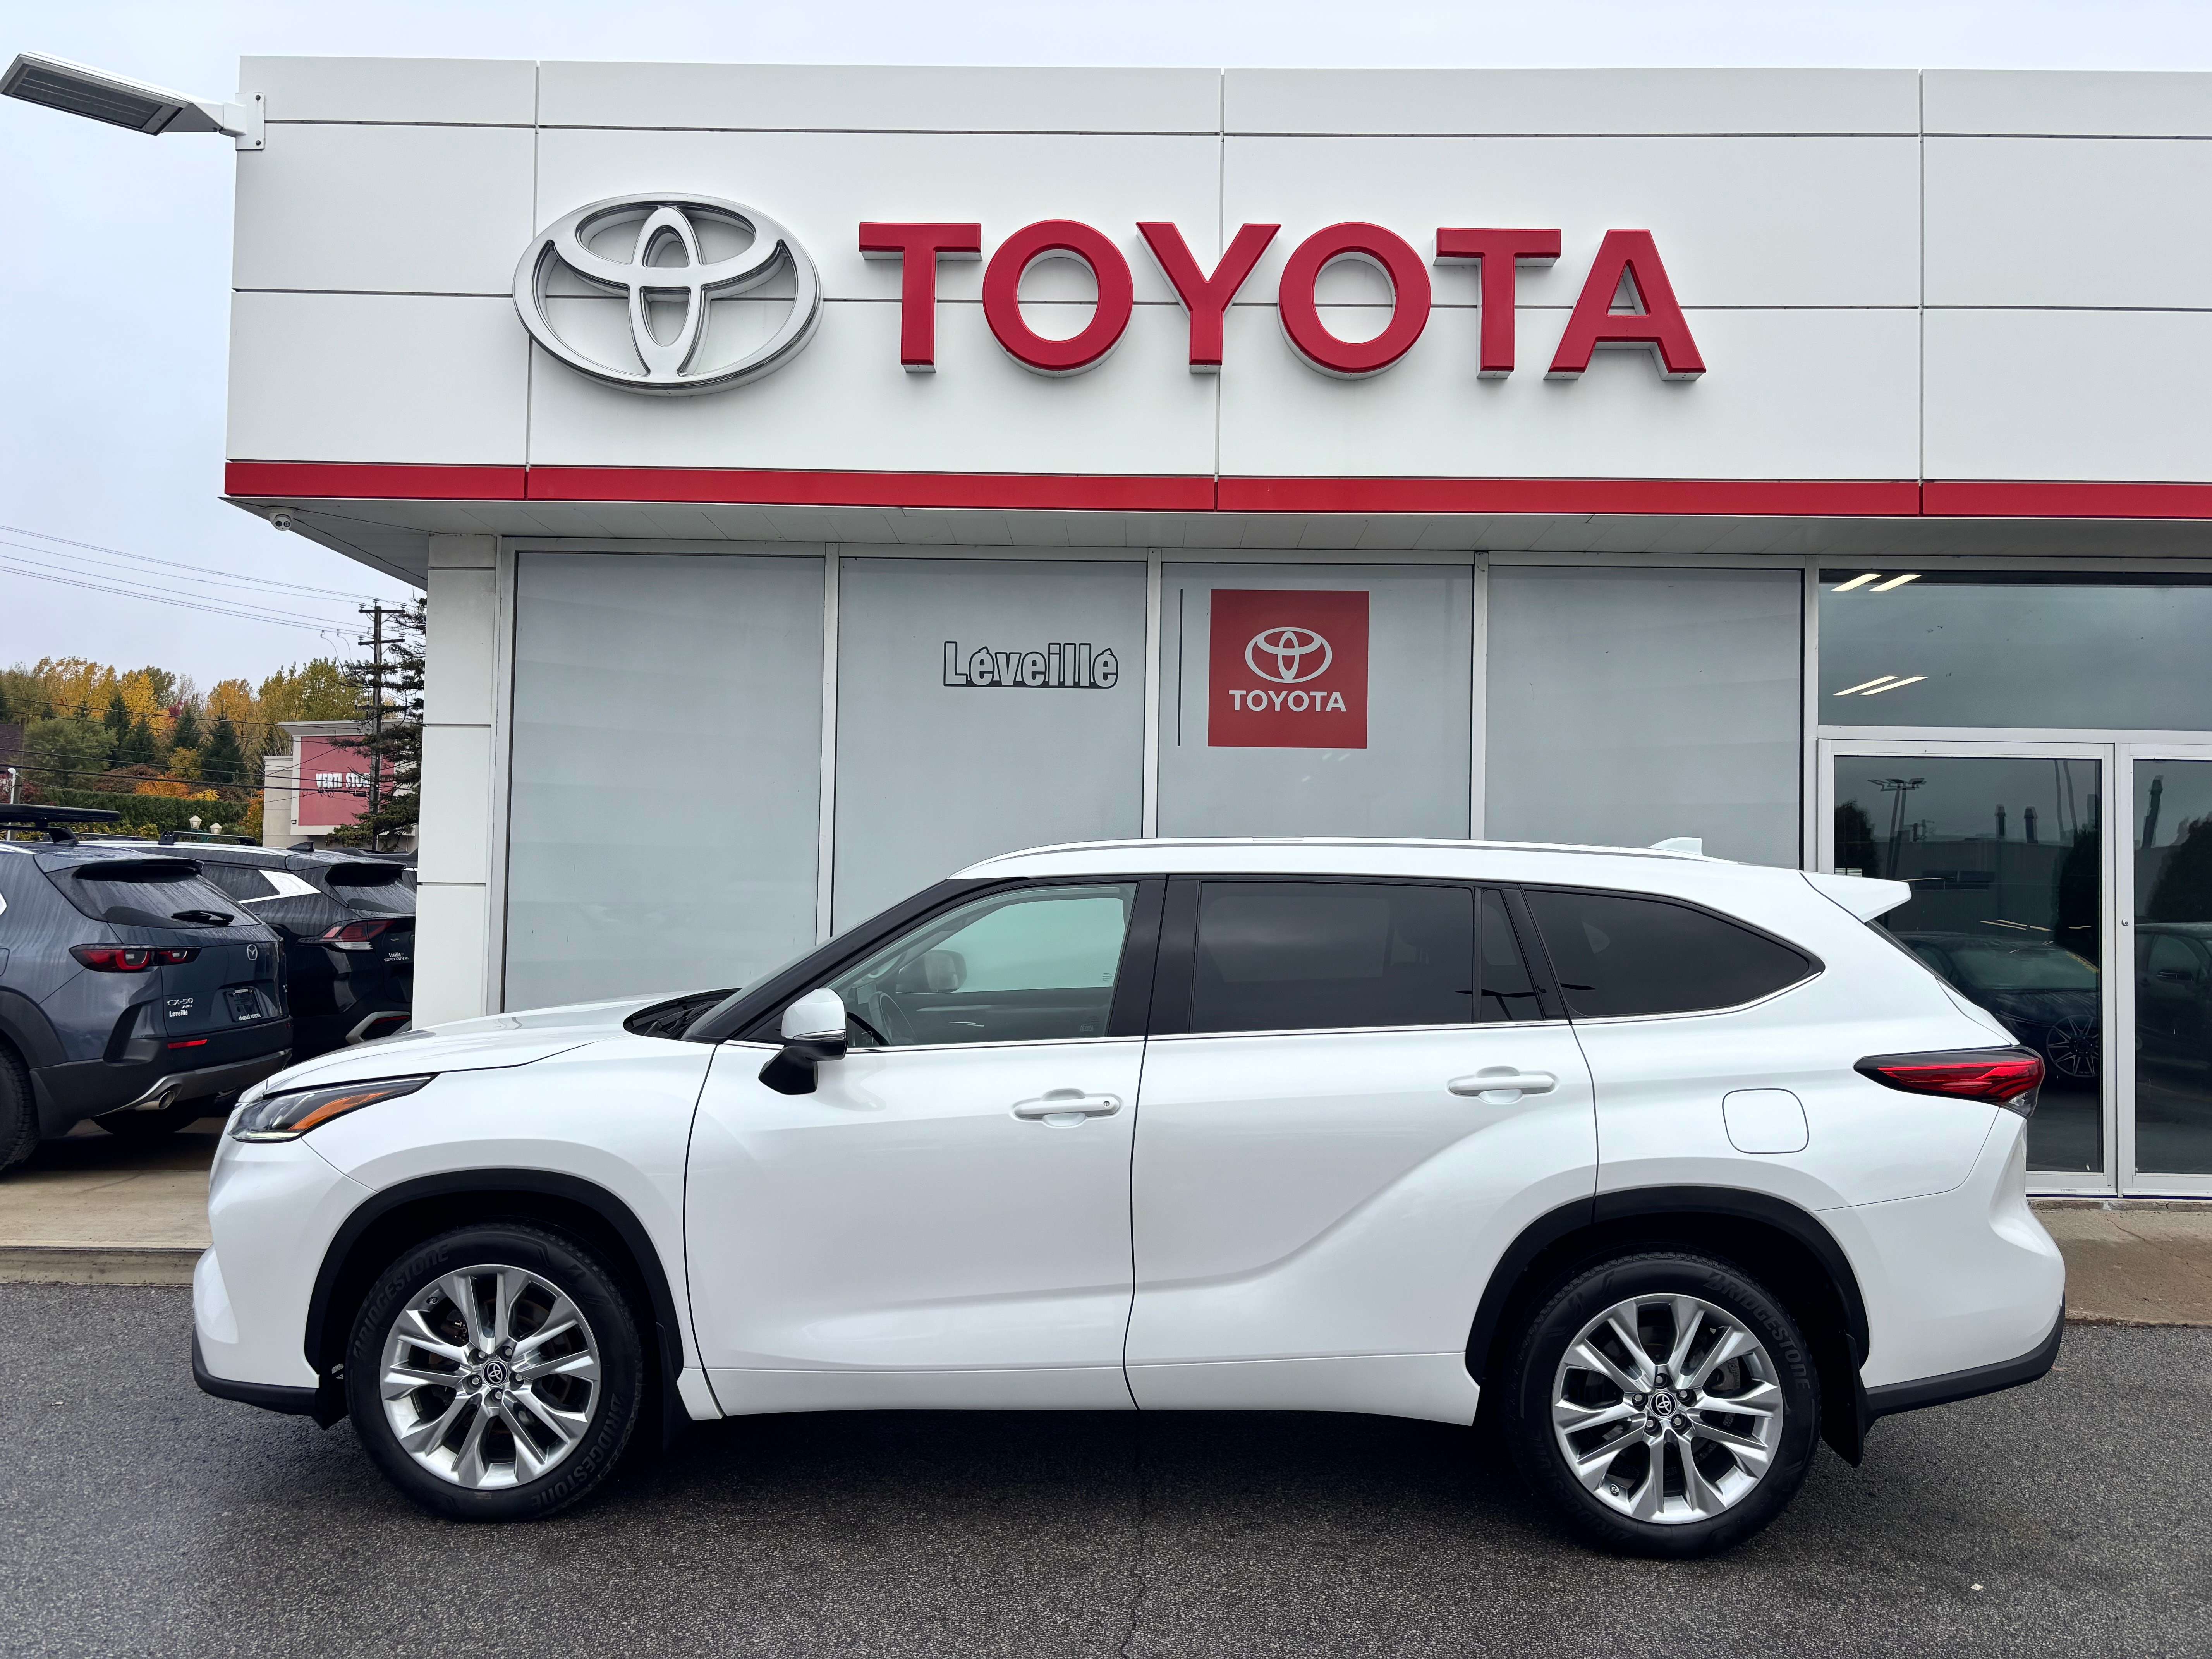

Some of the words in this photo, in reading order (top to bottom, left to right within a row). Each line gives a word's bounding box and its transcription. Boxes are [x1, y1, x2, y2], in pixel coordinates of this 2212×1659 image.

[859, 219, 1706, 381] TOYOTA
[943, 641, 1118, 689] Léveillé
[1229, 690, 1347, 712] TOYOTA
[316, 773, 342, 788] VERTI
[346, 773, 370, 788] STOR
[167, 998, 194, 1006] CX-50
[353, 1243, 450, 1360] BRIDGESTONE
[1702, 1271, 1811, 1391] BRIDGESTONE
[531, 1392, 623, 1508] BRIDGESTONE
